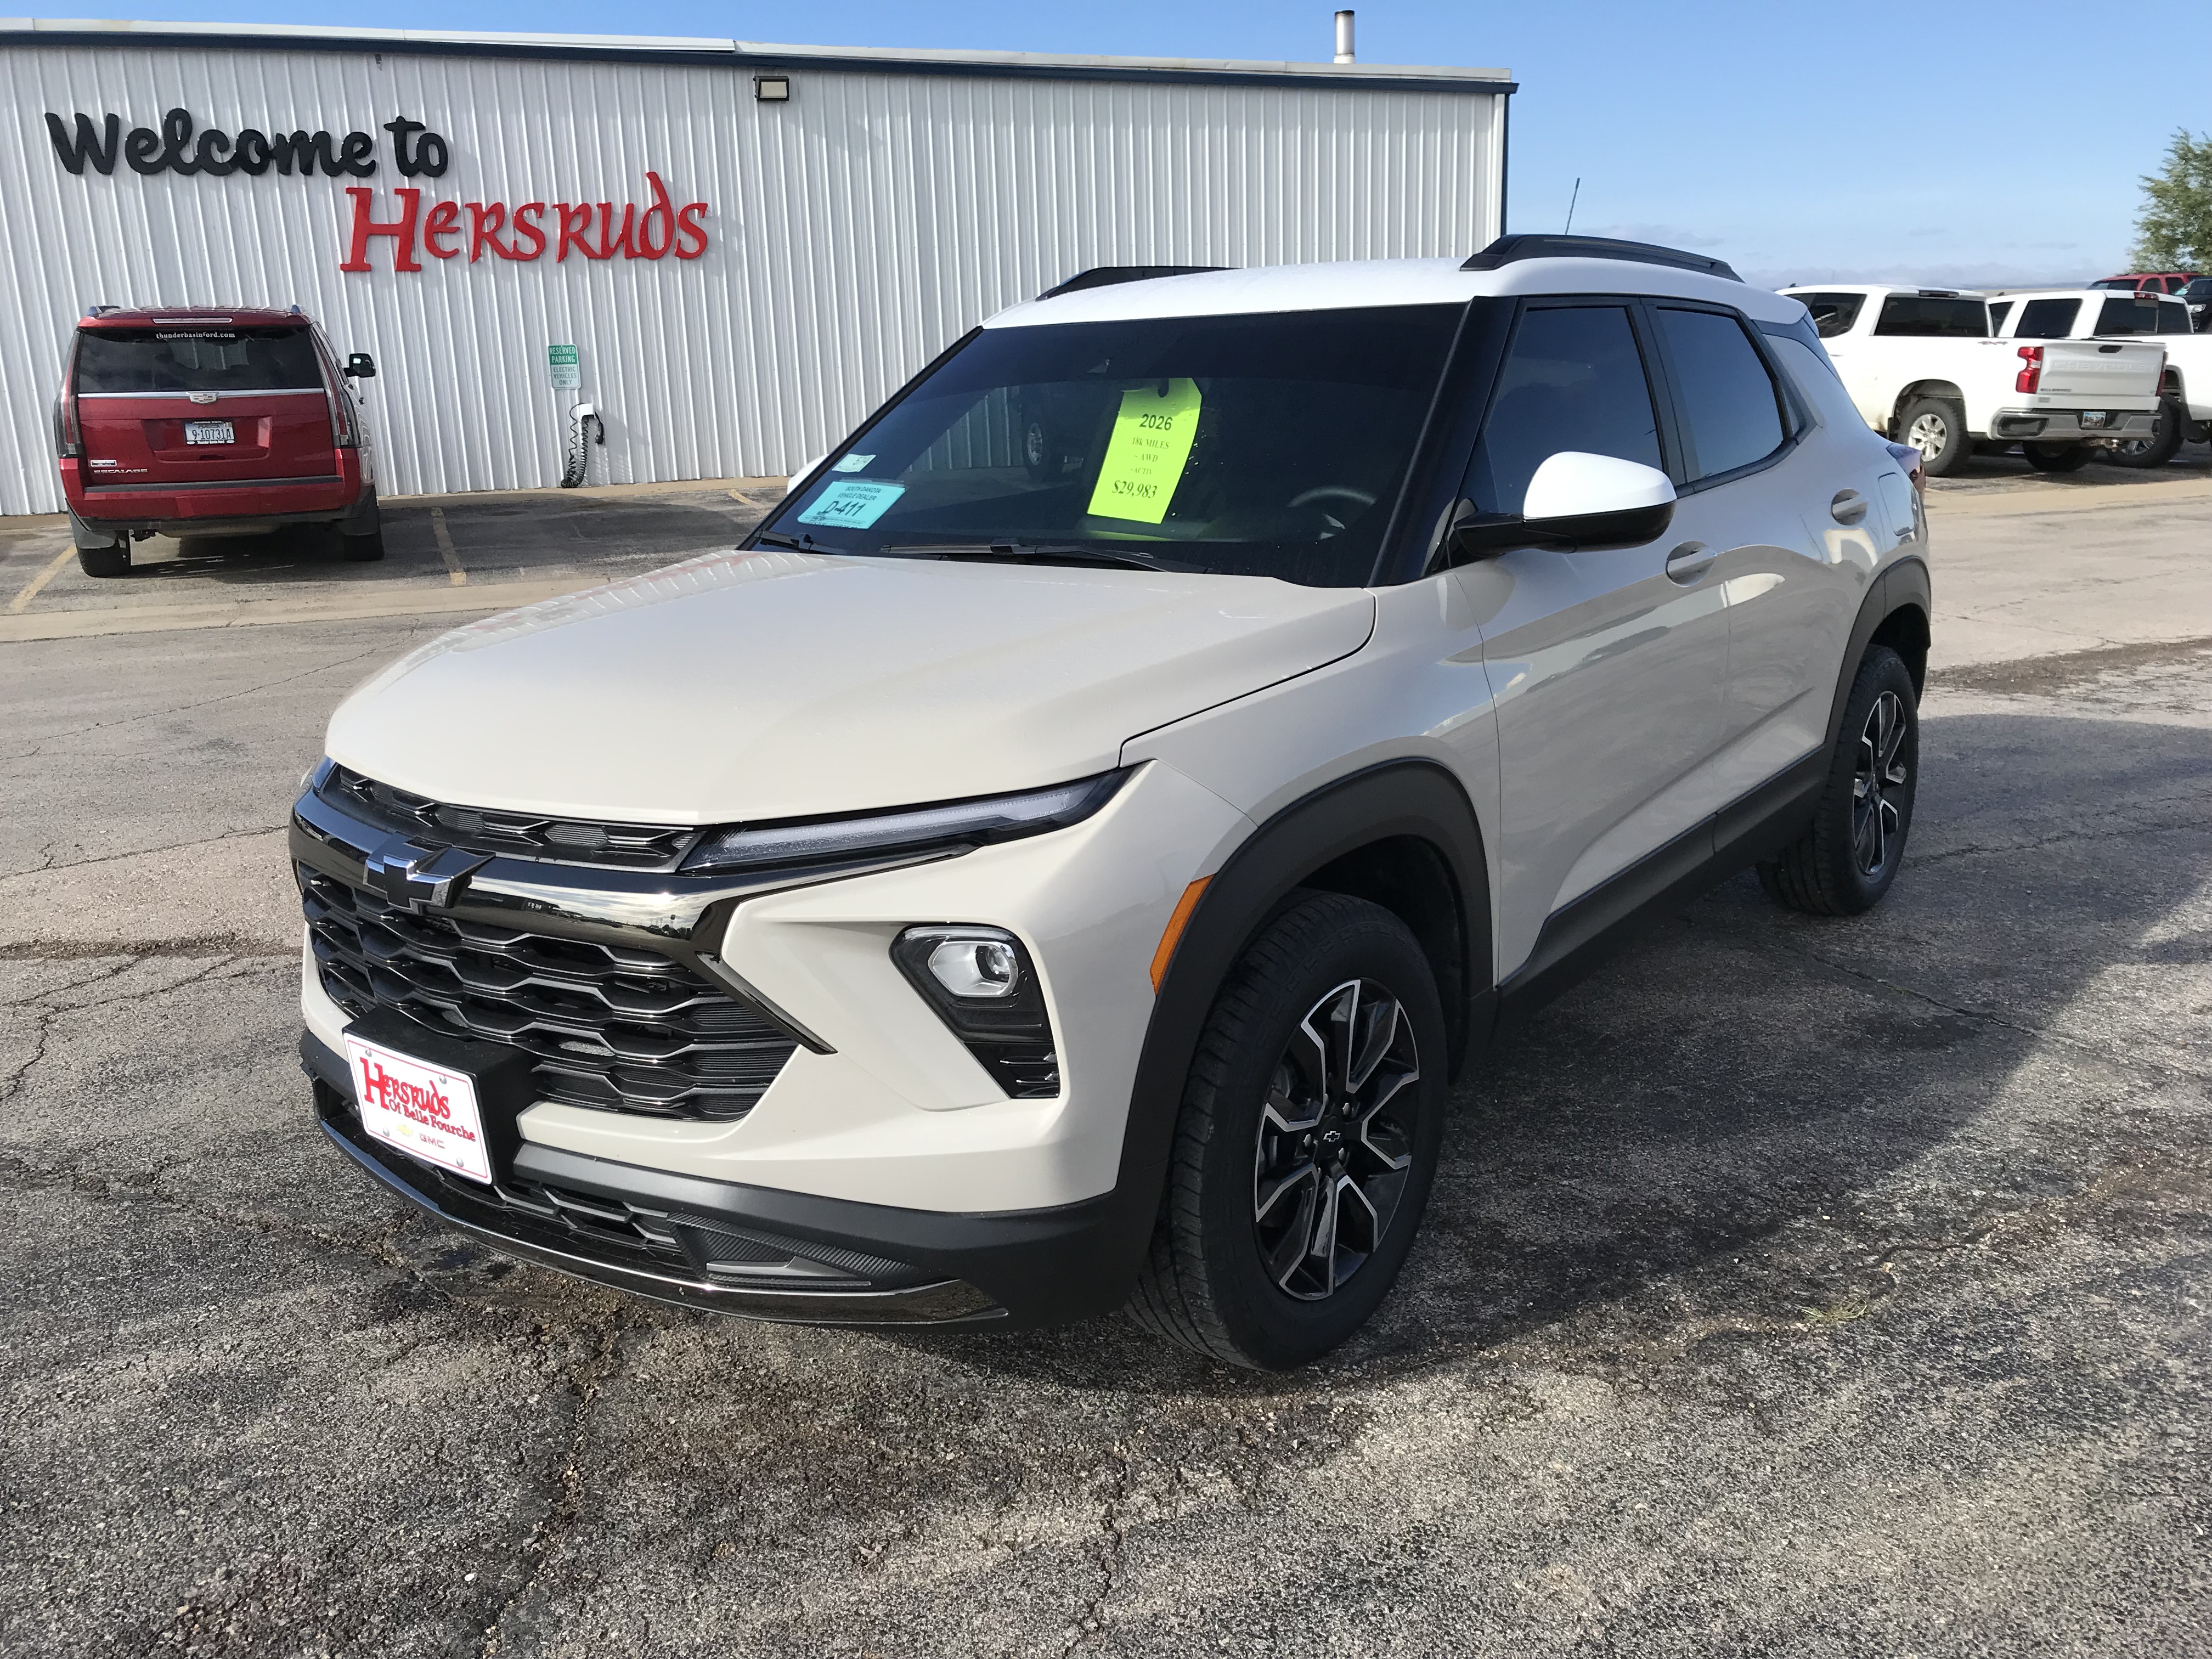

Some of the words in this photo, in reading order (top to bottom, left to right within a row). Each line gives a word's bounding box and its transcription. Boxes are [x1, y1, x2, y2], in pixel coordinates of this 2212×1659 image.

[44, 108, 376, 177] Welcome
[383, 116, 449, 178] to
[549, 347, 576, 355] RESERVED
[2053, 360, 2157, 372] CHEVROLET
[1139, 414, 1173, 431] 2026
[1144, 439, 1170, 449] MILES
[1139, 453, 1158, 462] AWD
[1111, 480, 1158, 499] $29,983
[389, 1099, 402, 1114] Of
[402, 1104, 430, 1126] Belle
[429, 1115, 476, 1142] Fourche
[419, 1132, 446, 1150] GMC
